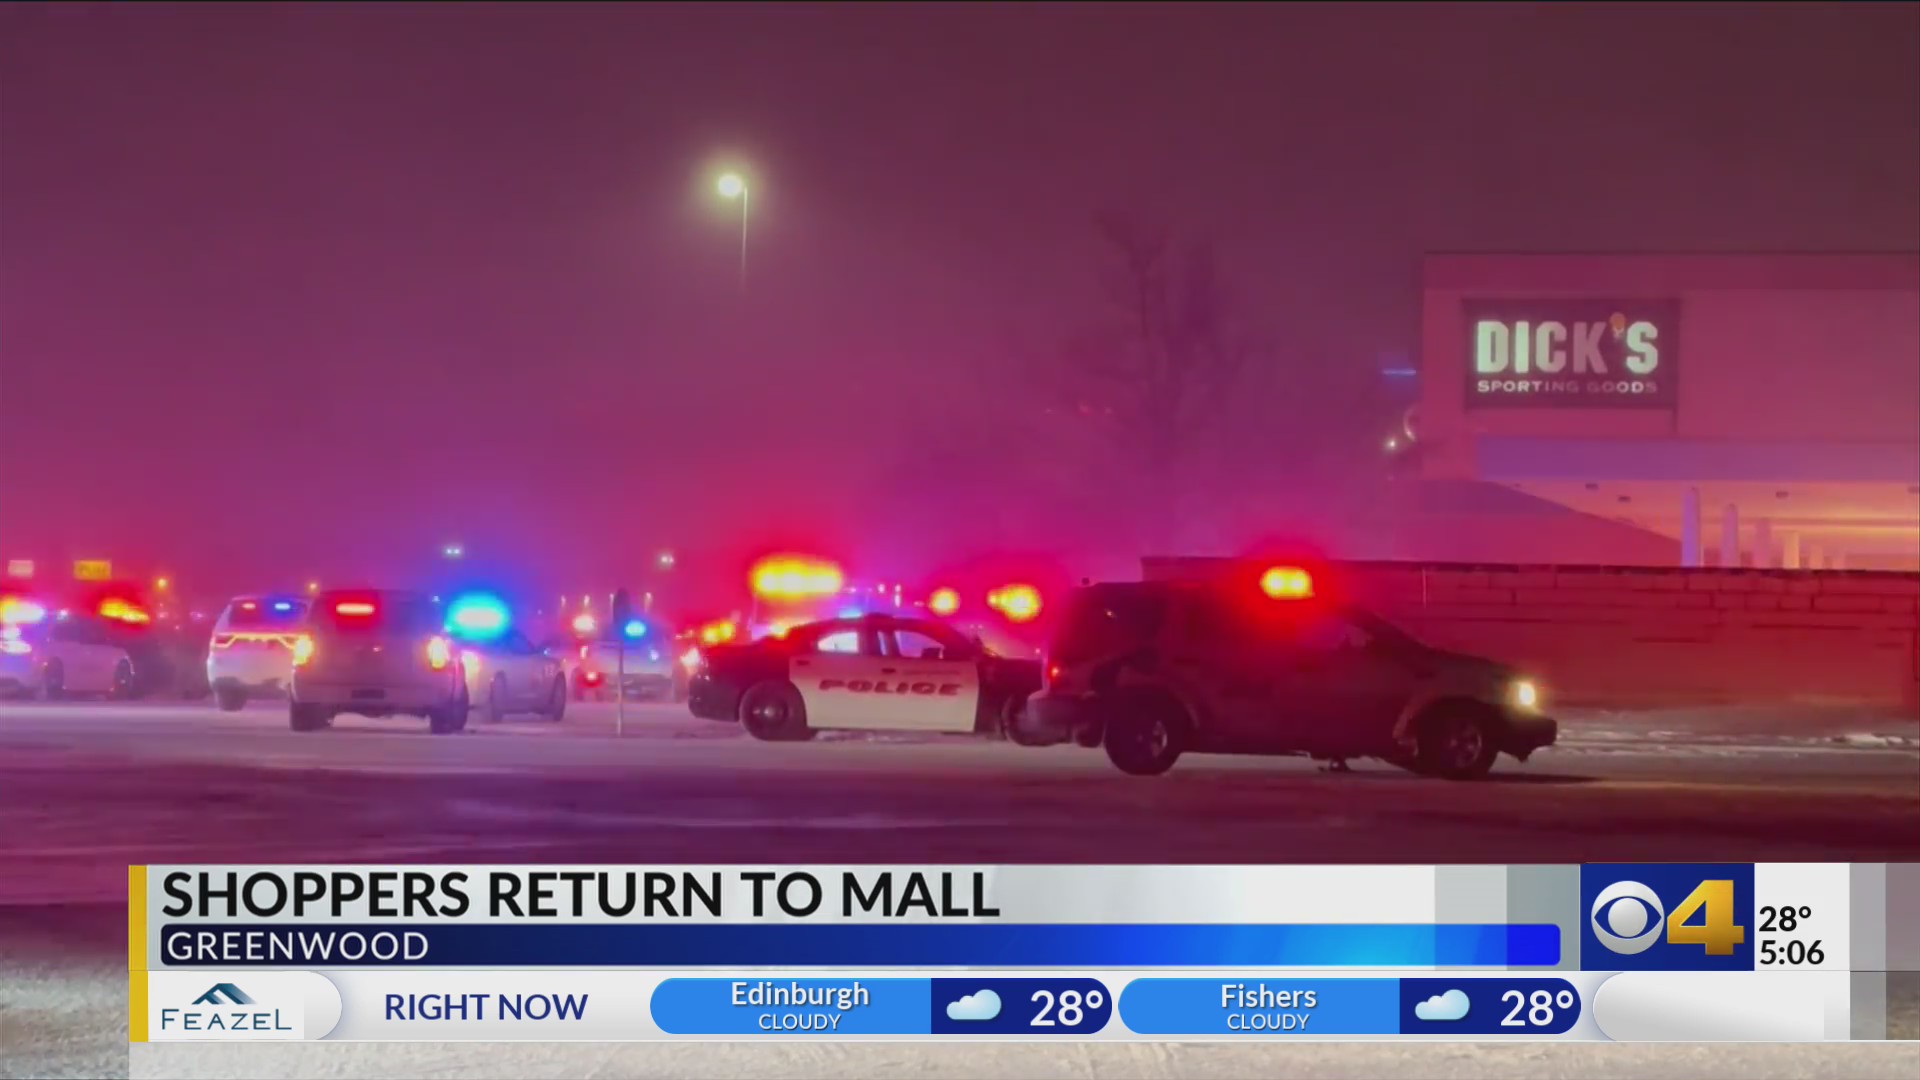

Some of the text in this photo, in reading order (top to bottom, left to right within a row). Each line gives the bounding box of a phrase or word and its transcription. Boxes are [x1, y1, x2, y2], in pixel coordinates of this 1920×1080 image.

[1476, 313, 1659, 374] DICK'S
[1477, 379, 1659, 394] SPORTING GOODS
[818, 679, 964, 696] POLICE
